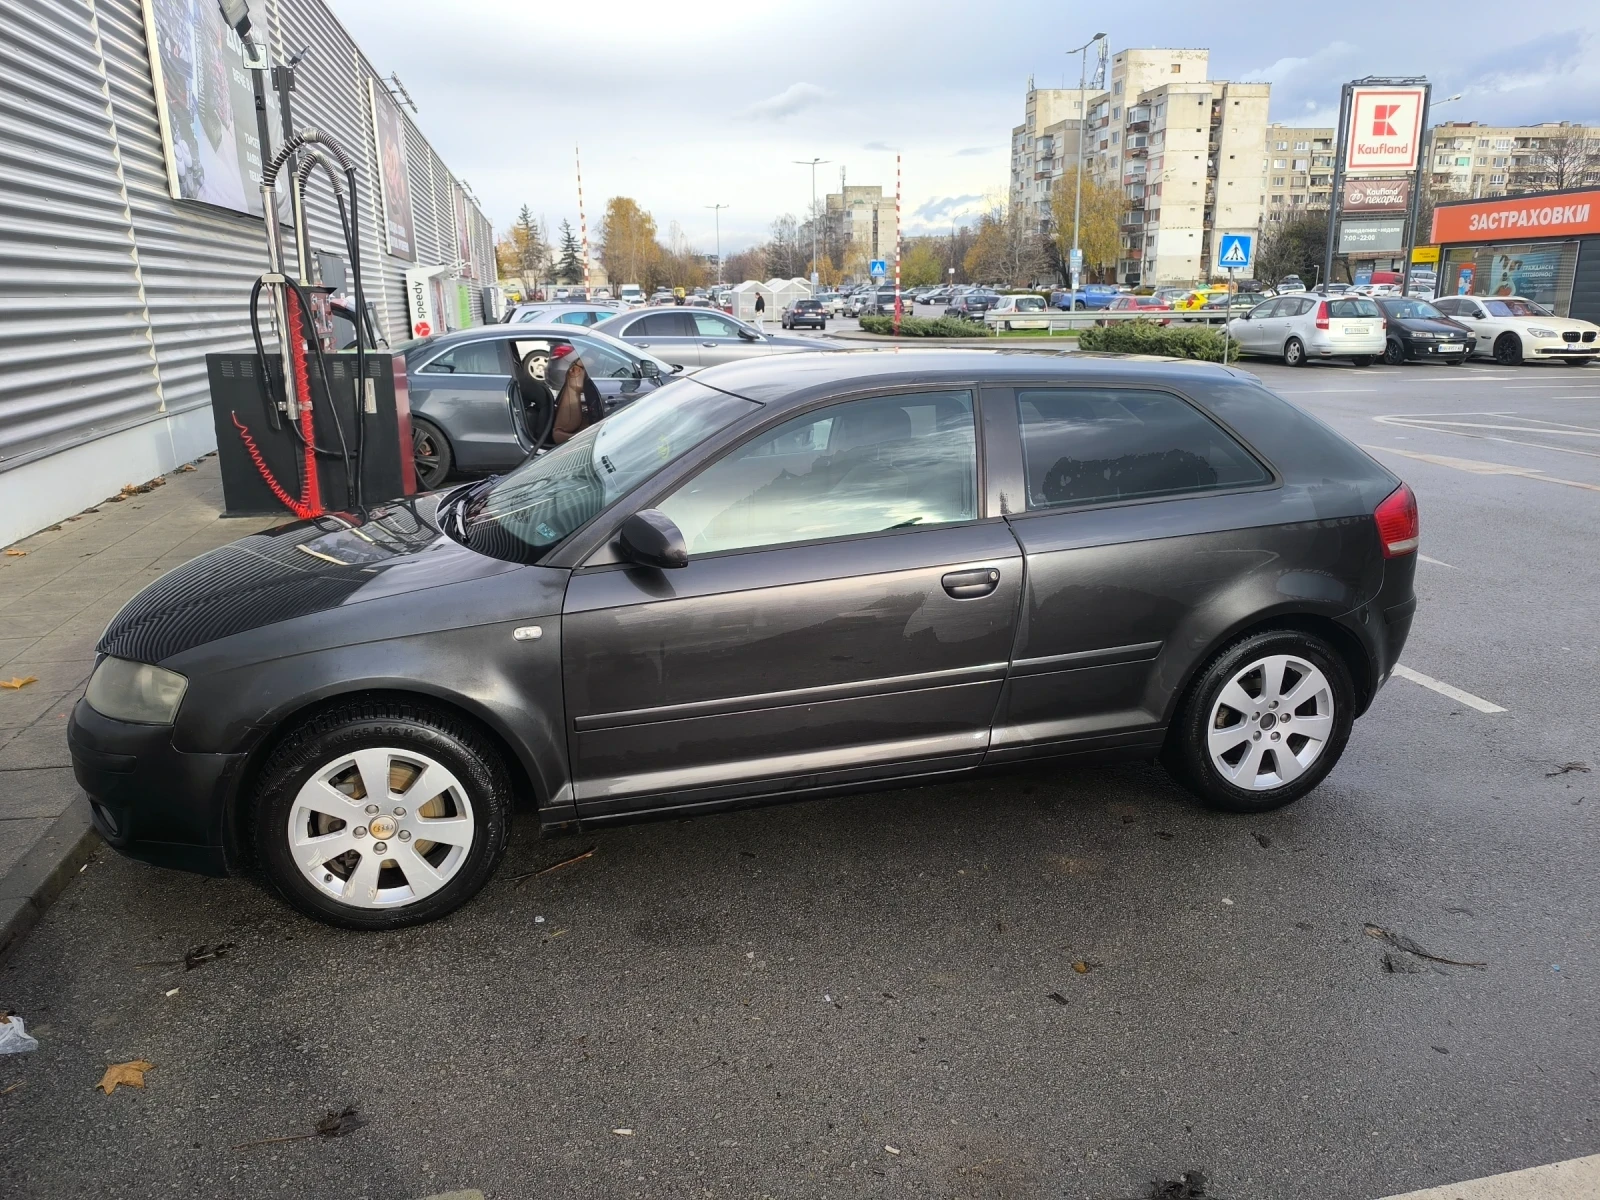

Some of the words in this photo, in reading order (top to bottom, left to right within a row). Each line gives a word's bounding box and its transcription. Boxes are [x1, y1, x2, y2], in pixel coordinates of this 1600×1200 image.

[1357, 143, 1408, 154] Kaufland
[1365, 195, 1403, 205] пекарна
[1469, 204, 1591, 231] ЗАСТРАХОВКИ
[412, 281, 427, 318] speedy
